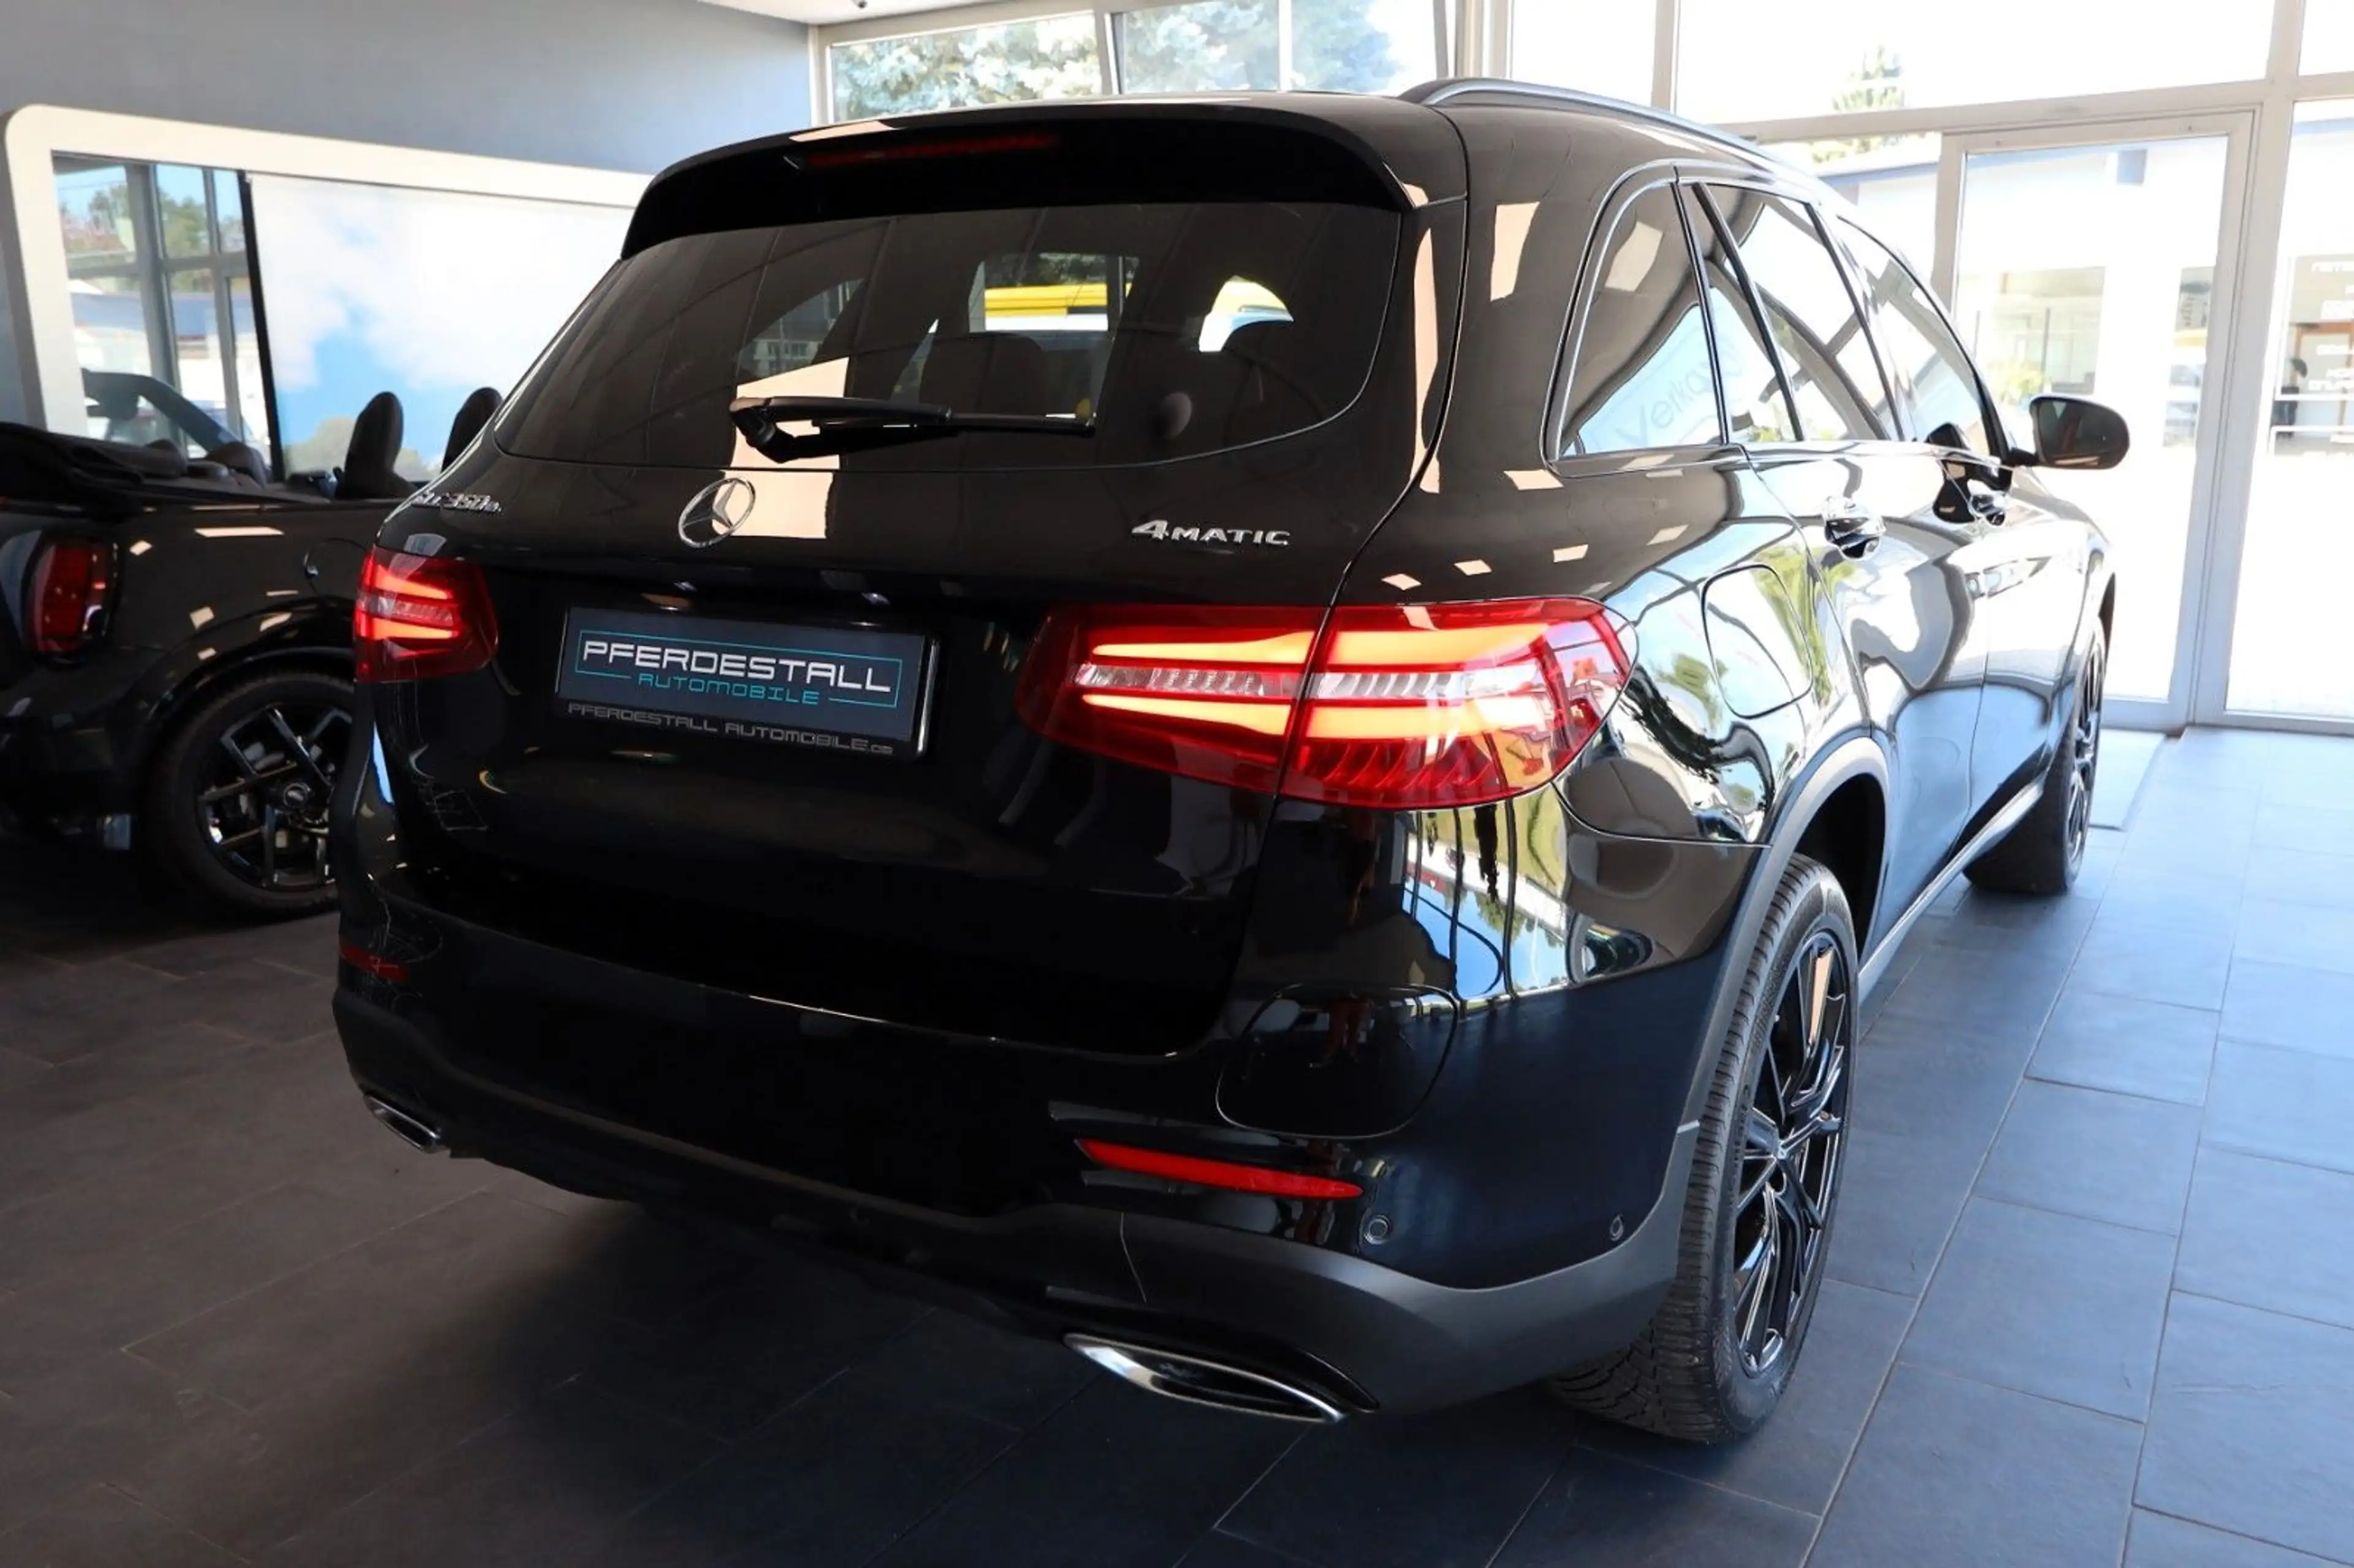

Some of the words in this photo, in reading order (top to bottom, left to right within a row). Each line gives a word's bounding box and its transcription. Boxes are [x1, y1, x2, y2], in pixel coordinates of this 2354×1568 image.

[1131, 519, 1290, 546] 4MATIC
[582, 640, 892, 693] PFERDESTALL
[638, 673, 820, 705] AUTOMOBILE
[568, 701, 718, 733] PFERDESTALL
